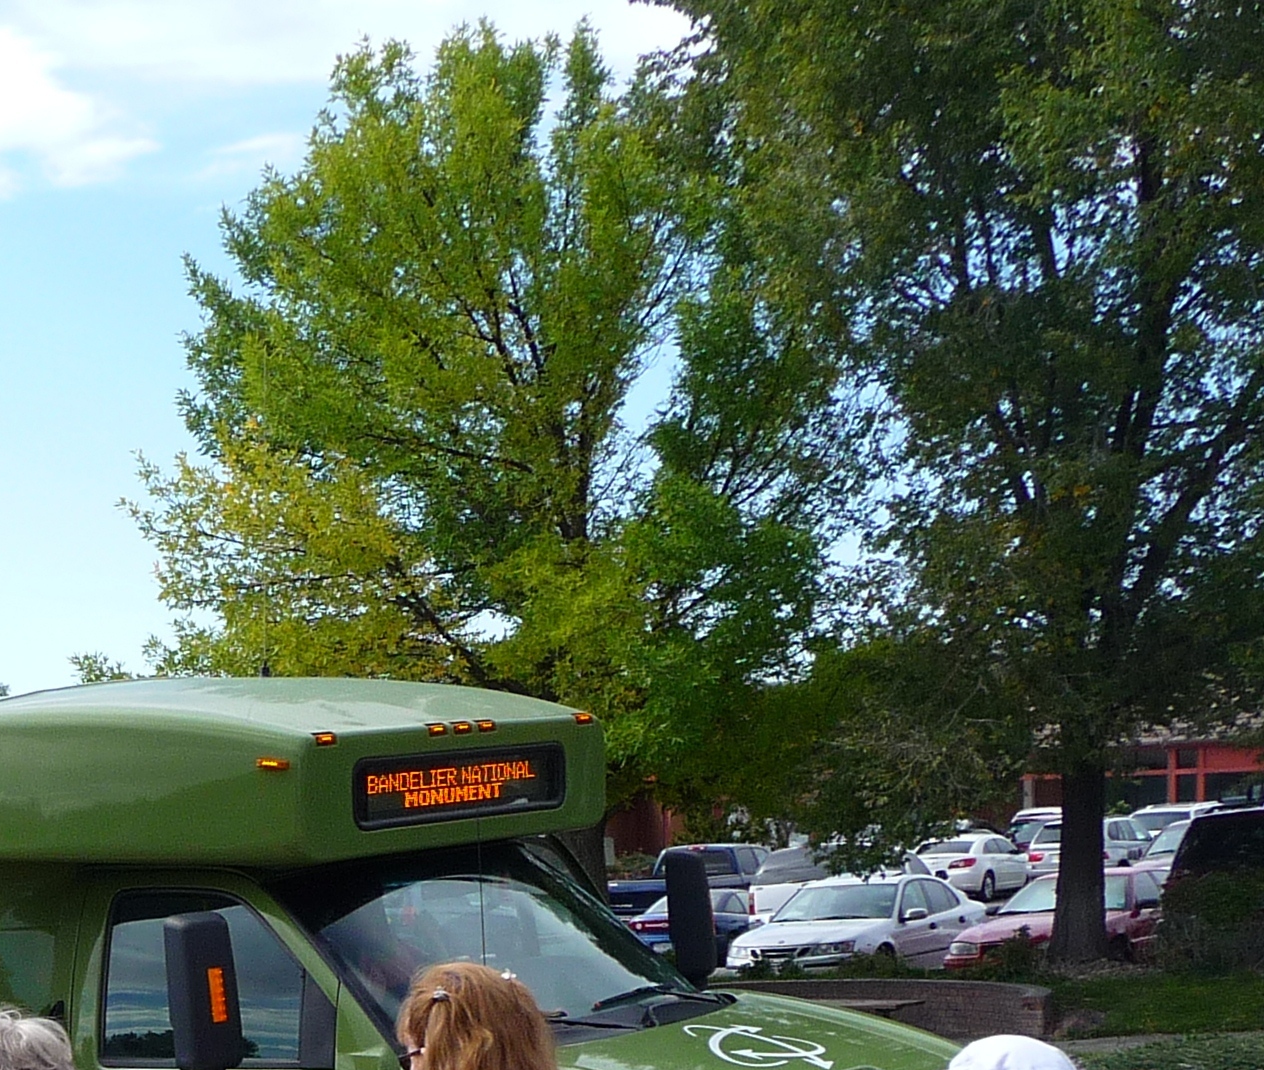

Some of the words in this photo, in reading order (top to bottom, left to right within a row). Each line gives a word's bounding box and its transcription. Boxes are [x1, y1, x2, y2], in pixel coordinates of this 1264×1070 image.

[367, 767, 457, 794] BANDELIER
[461, 760, 535, 785] NATIONAL
[404, 782, 503, 808] MONUMENT
